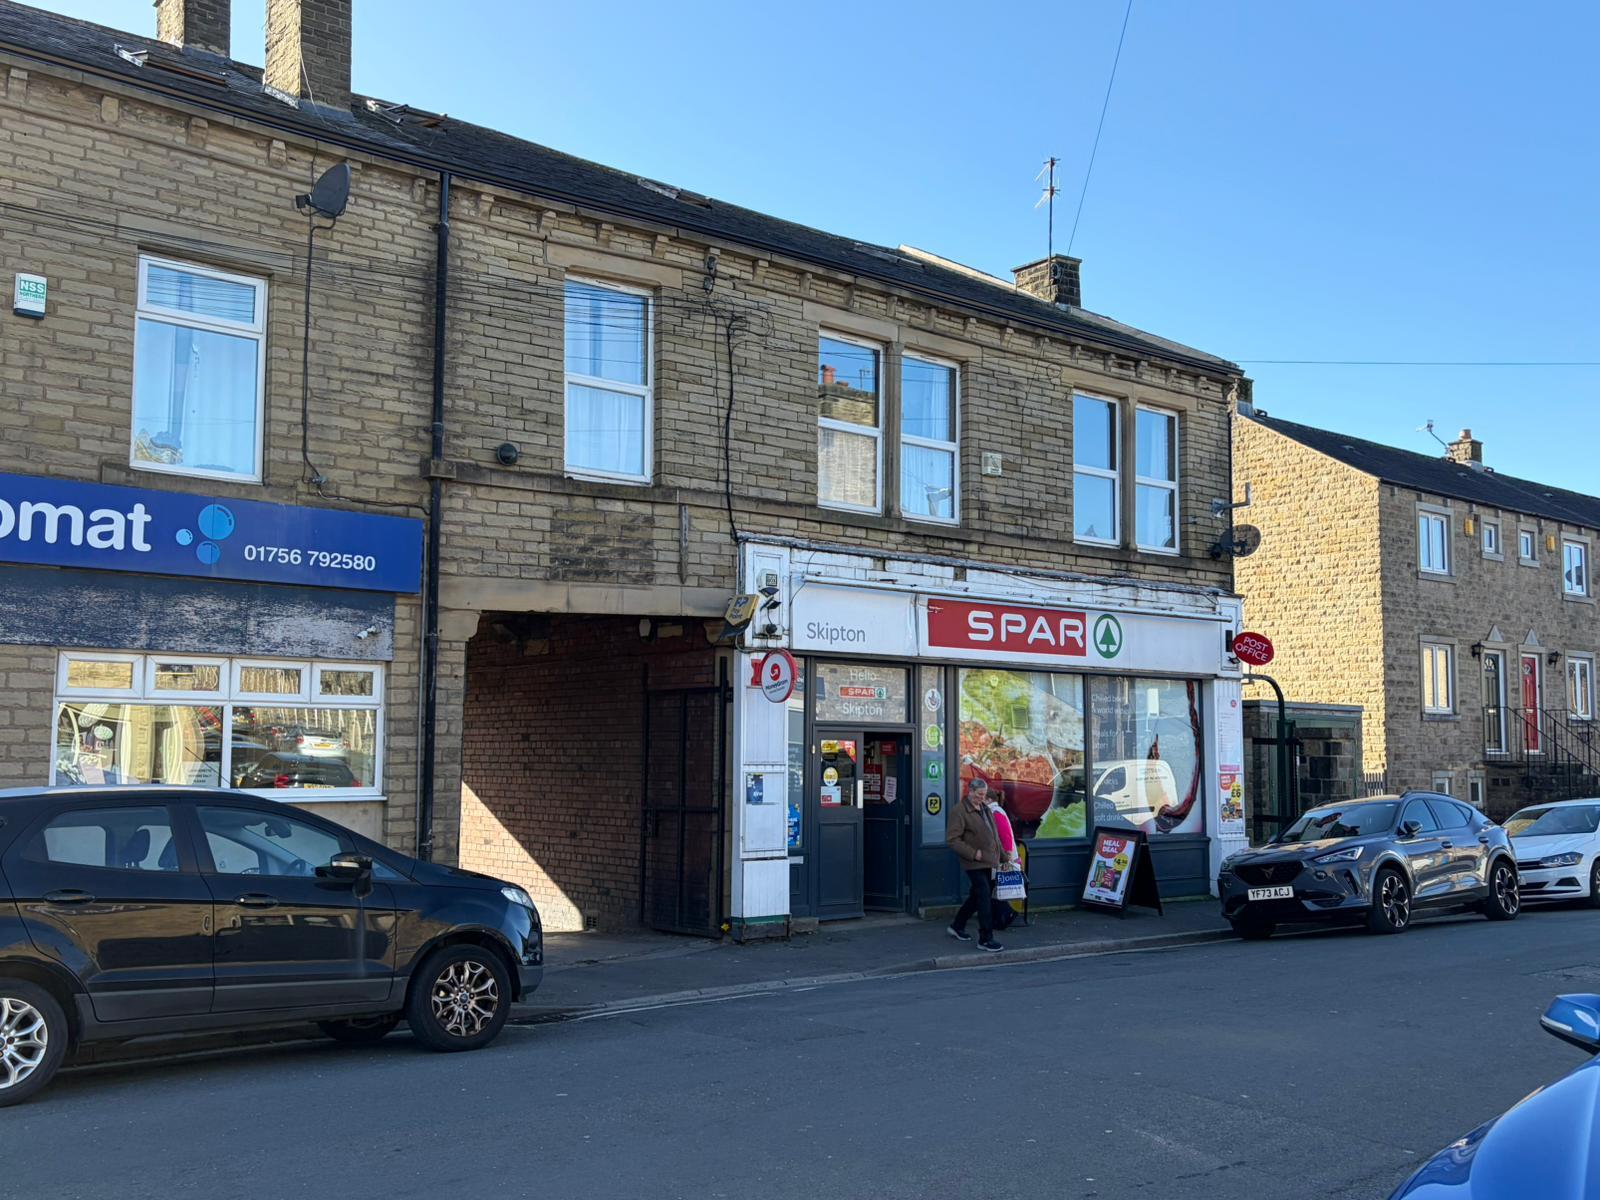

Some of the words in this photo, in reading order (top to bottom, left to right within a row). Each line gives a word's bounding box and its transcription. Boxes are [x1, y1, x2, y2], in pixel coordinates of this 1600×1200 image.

[20, 280, 45, 294] NSS
[244, 544, 301, 565] 01756
[307, 550, 376, 571] 792580
[806, 621, 866, 644] Skipton
[967, 610, 1084, 648] SPAR
[1243, 636, 1268, 652] POST
[1235, 642, 1268, 662] OFFICE
[849, 669, 877, 681] Hello
[848, 687, 875, 696] SPAR
[842, 701, 882, 717] Skipton
[1232, 788, 1241, 798] £6
[1102, 845, 1119, 854] DEAL
[1103, 839, 1120, 848] MEAL
[1250, 890, 1272, 898] YF73
[1274, 888, 1290, 897] ACJ
